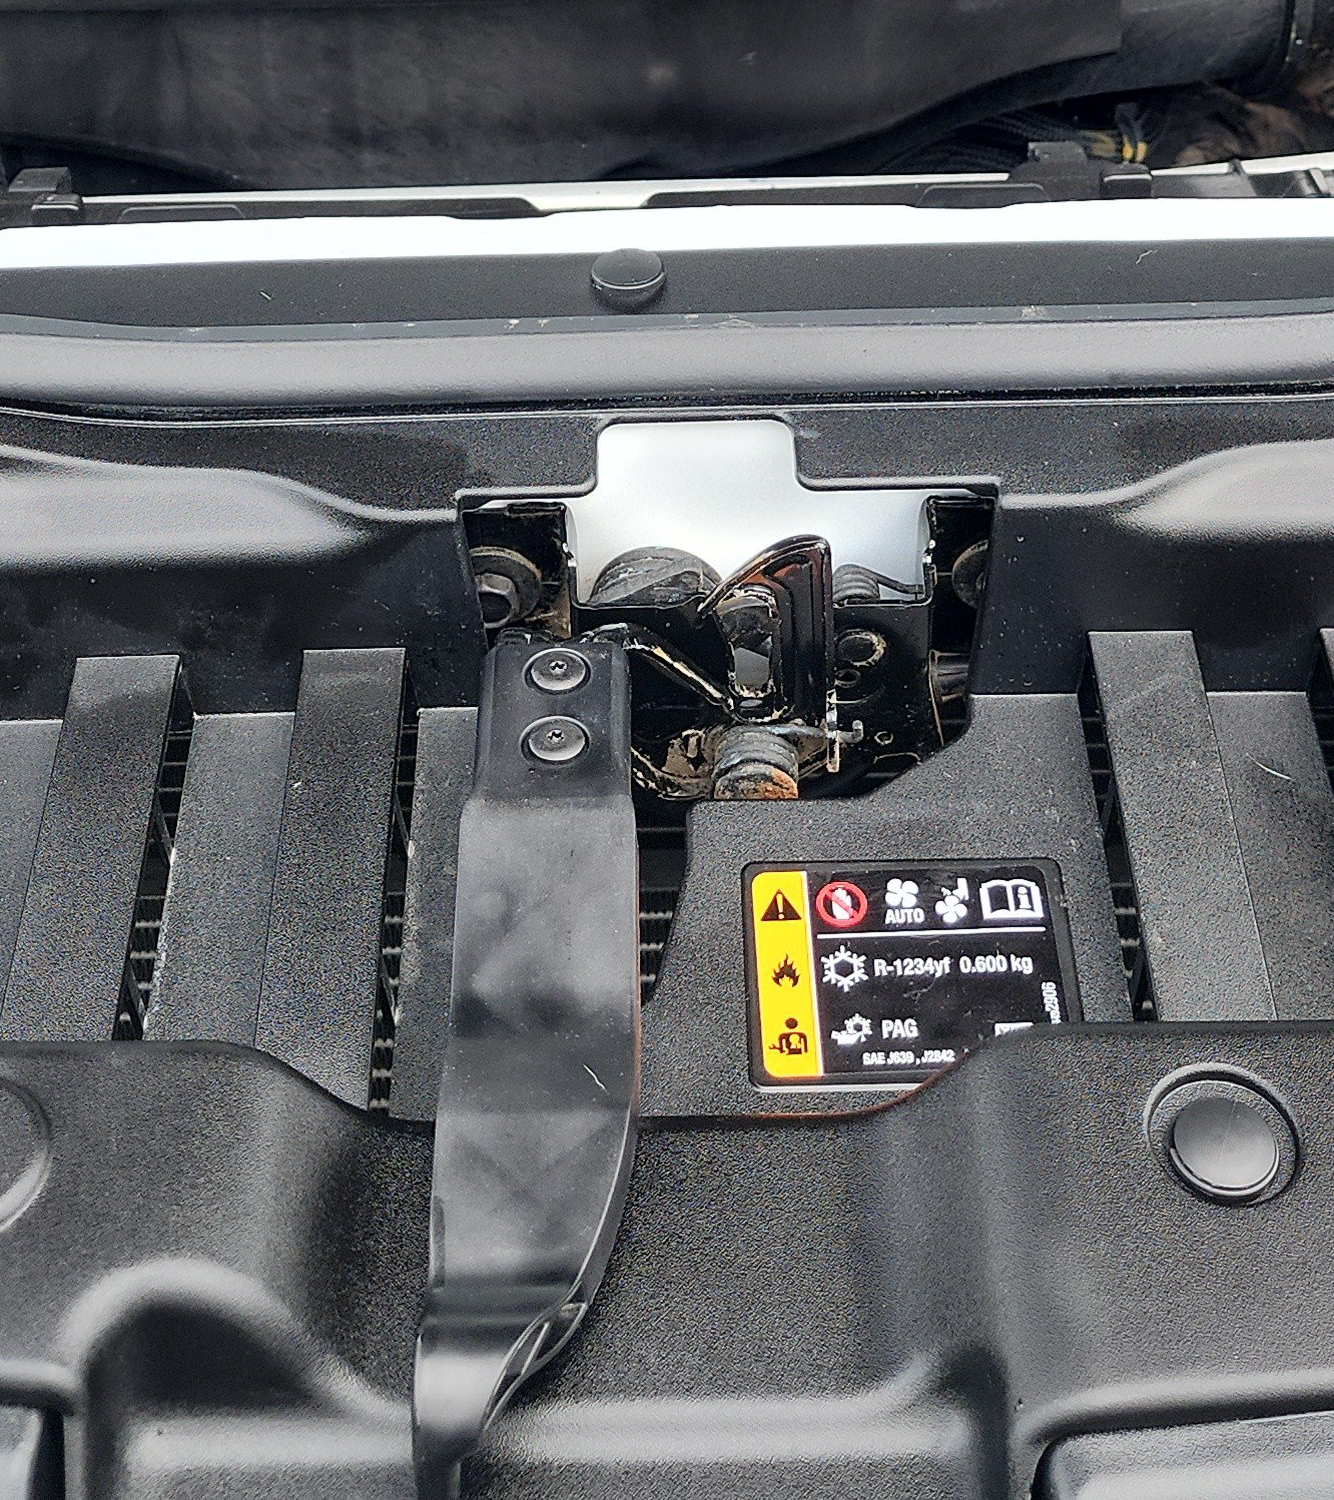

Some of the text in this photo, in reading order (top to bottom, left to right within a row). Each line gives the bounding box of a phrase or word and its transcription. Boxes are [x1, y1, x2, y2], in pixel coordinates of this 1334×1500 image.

[885, 908, 925, 924] AUTO
[873, 953, 1033, 978] R-1234yf 0.600 kg
[881, 1018, 919, 1039] PAG
[862, 1052, 886, 1065] SAE
